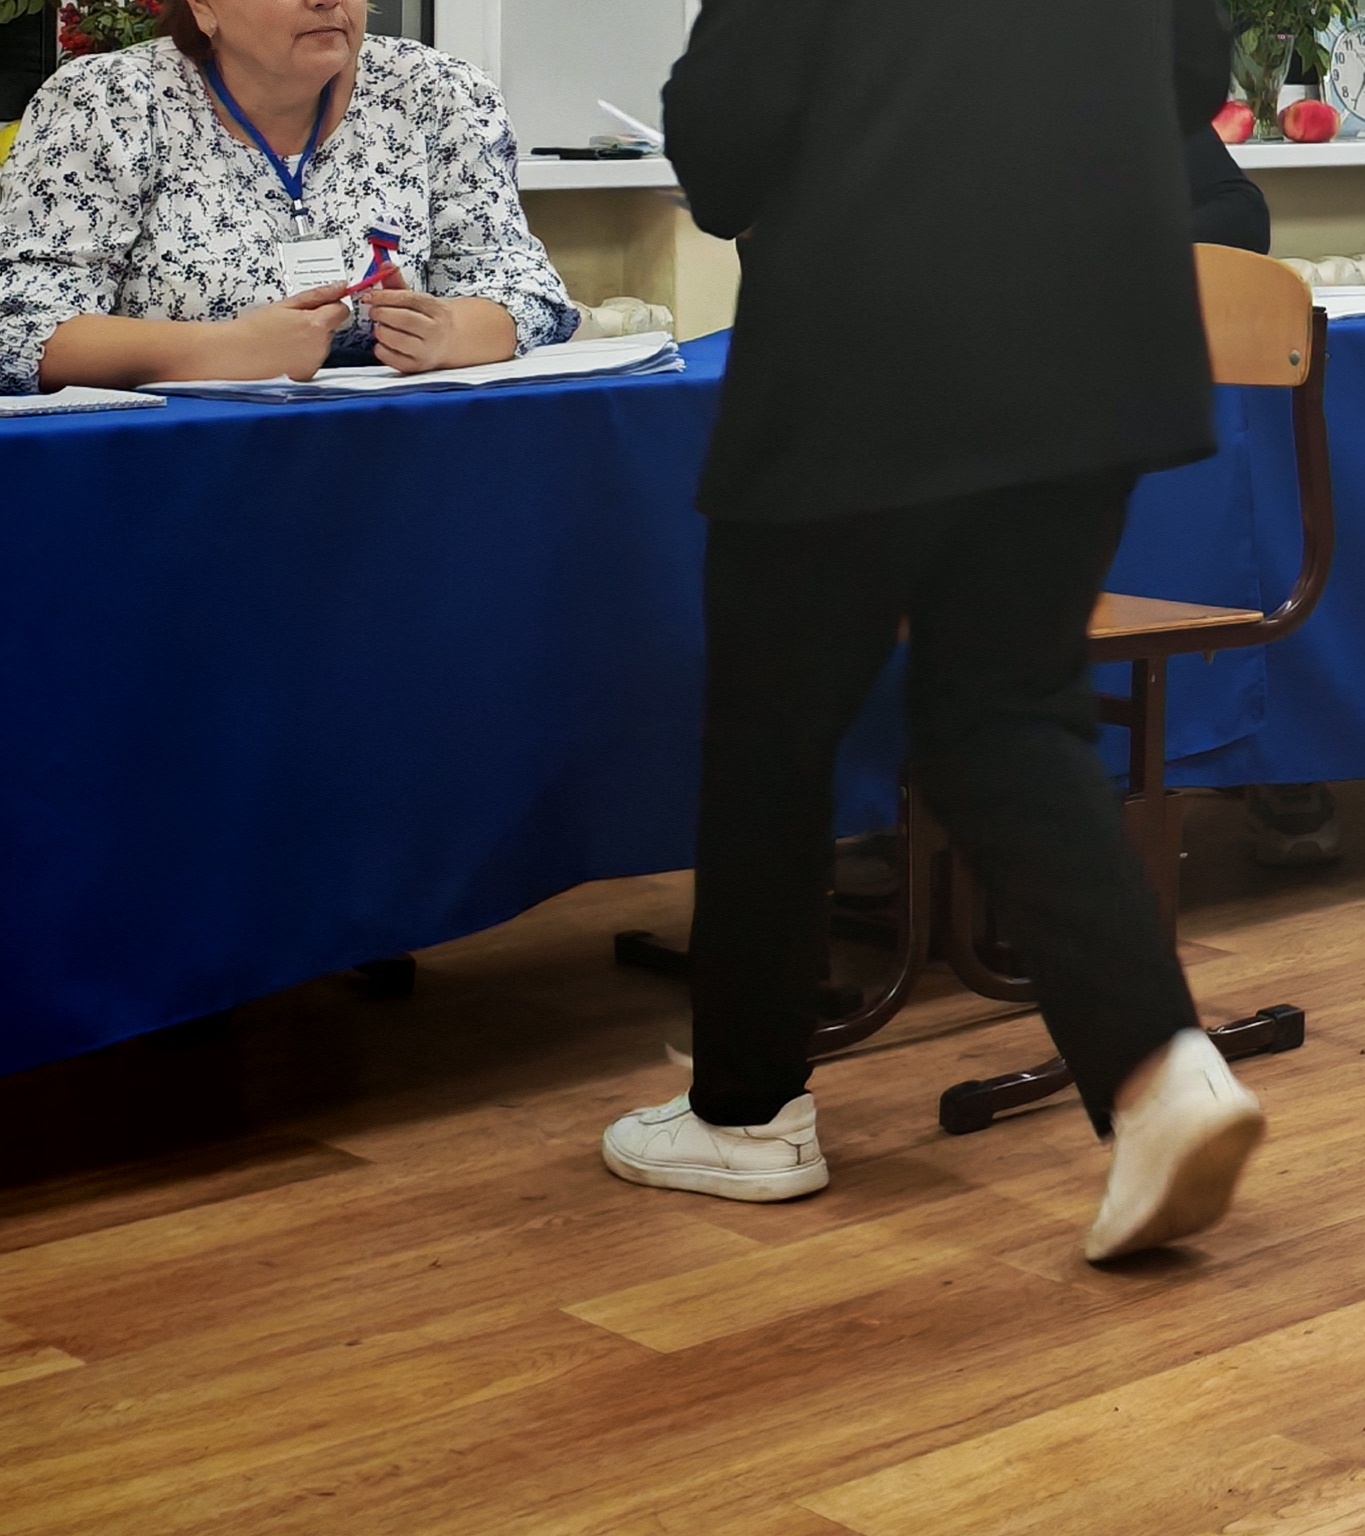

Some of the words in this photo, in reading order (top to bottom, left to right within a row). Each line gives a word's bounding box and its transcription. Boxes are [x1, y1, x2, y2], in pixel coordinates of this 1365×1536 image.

[1343, 39, 1353, 51] 11
[1334, 51, 1345, 64] 10
[1333, 69, 1339, 81] 9
[1341, 85, 1349, 98] 8
